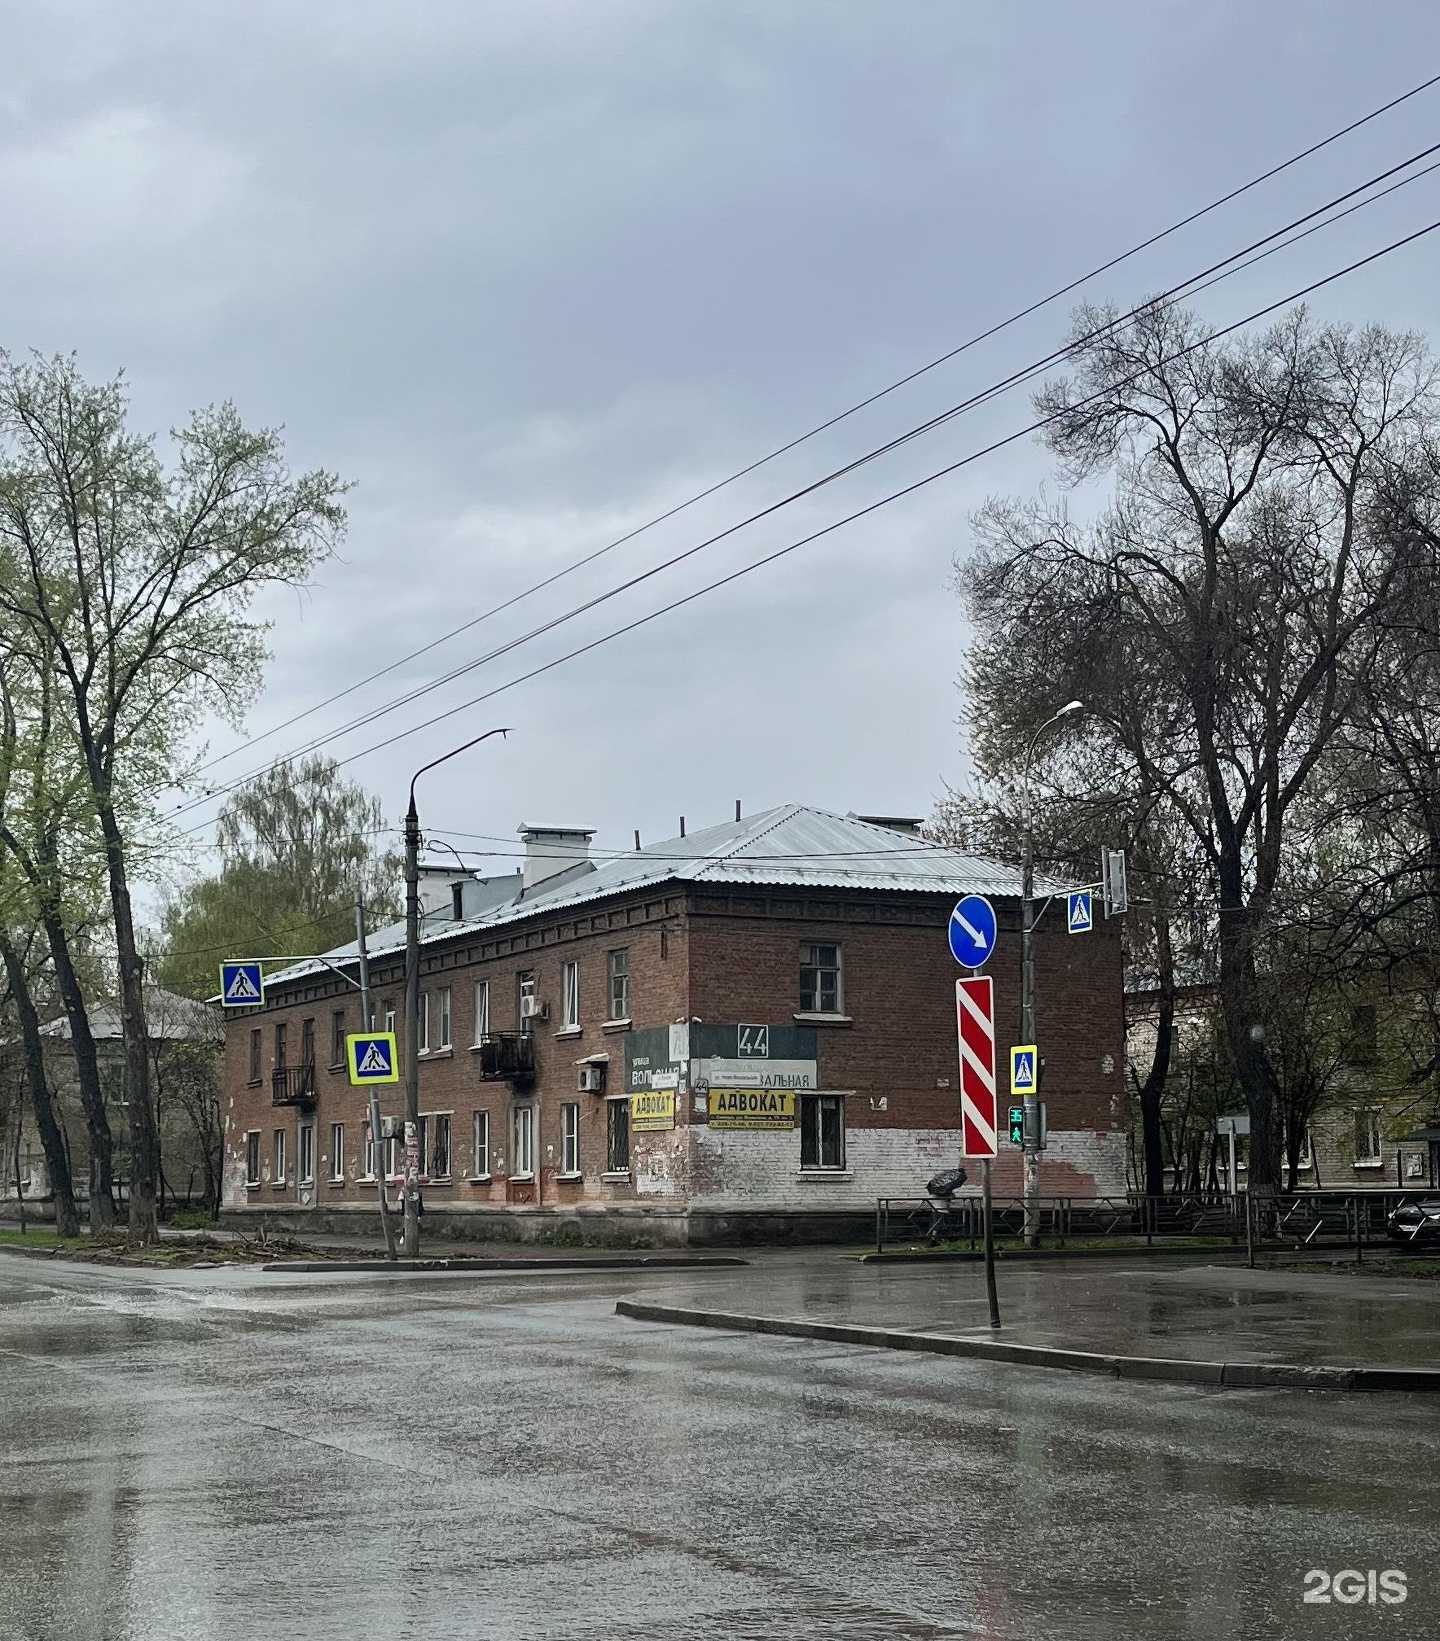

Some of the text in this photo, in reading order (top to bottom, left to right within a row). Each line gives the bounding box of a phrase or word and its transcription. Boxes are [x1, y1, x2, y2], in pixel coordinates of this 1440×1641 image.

[740, 1028, 767, 1054] 44
[636, 1095, 671, 1114] АДВОКАТ
[718, 1093, 787, 1112] АДВОКАТ
